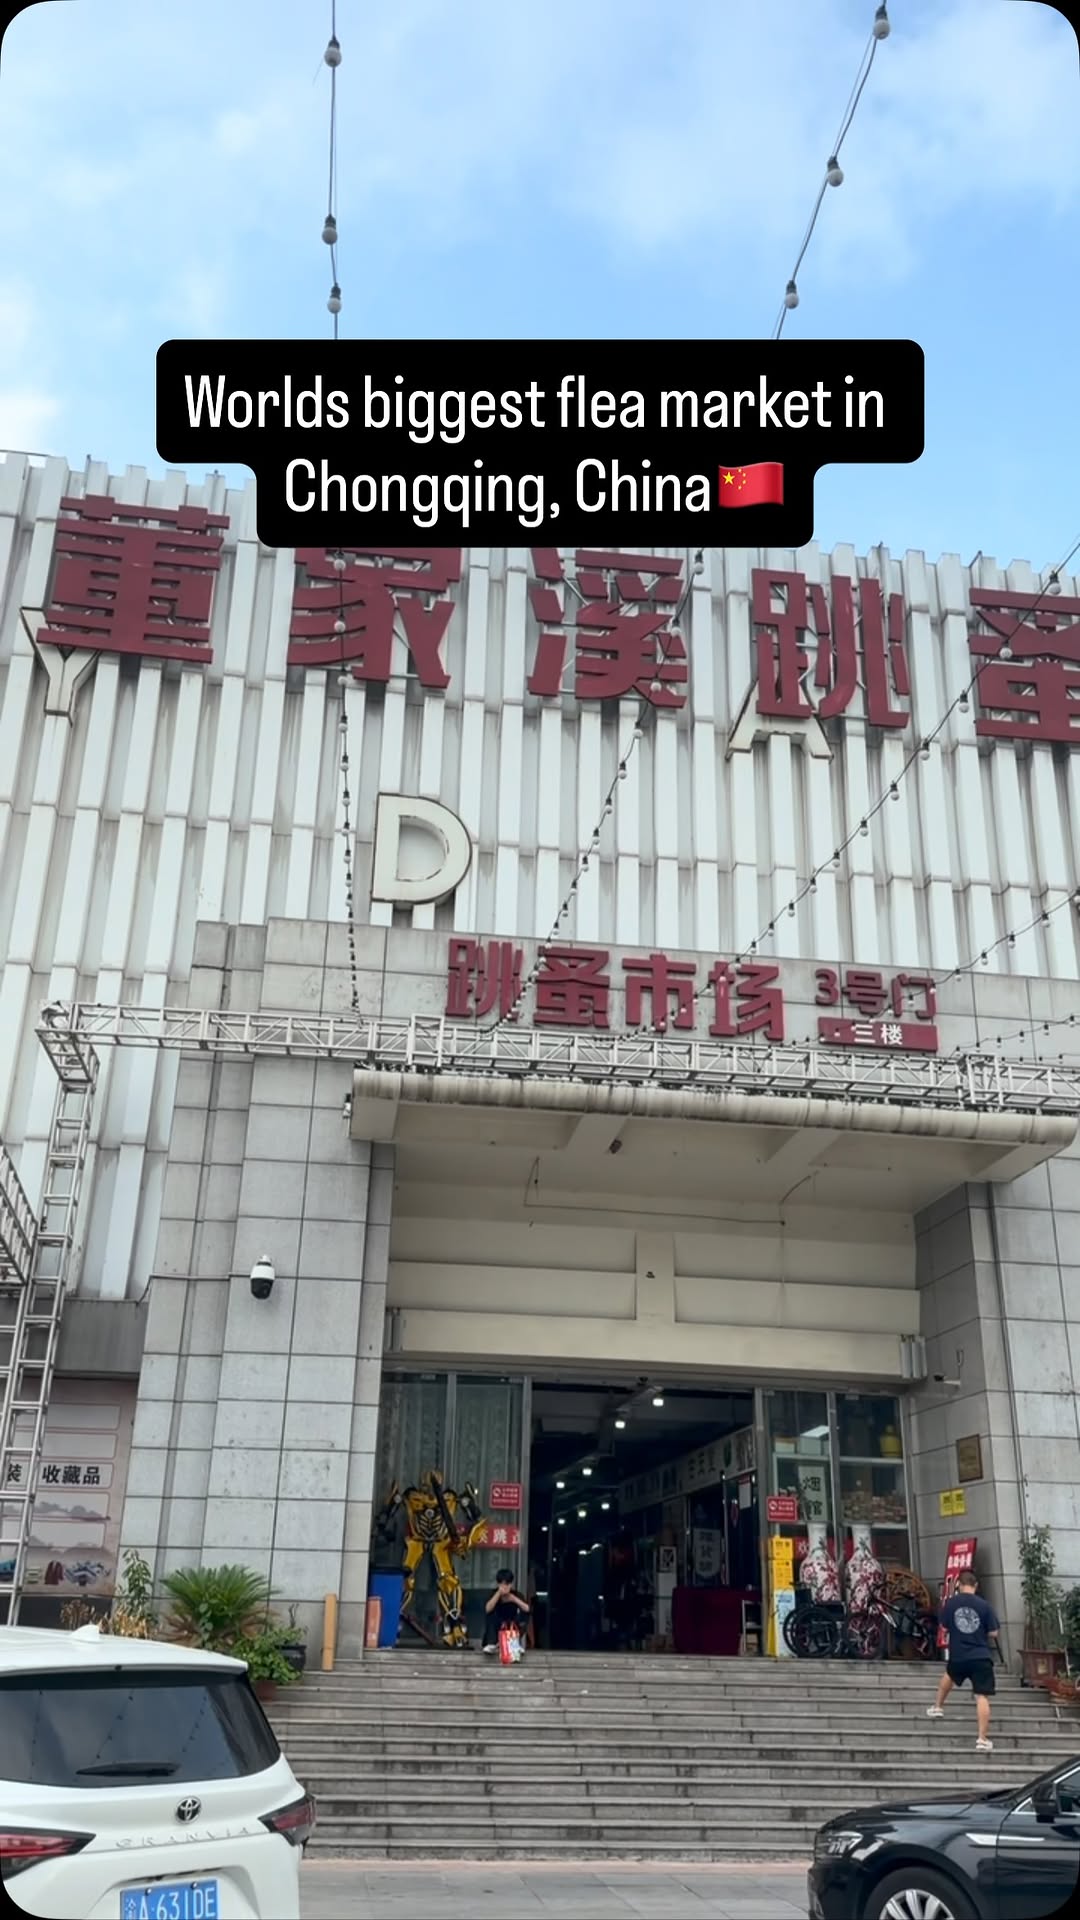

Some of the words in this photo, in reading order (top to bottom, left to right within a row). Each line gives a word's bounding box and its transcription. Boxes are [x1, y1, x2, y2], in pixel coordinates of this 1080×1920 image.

[370, 792, 473, 905] D
[445, 938, 785, 1042] 跳蚤市场
[814, 968, 937, 1019] 3号门
[853, 1023, 903, 1045] 三楼
[42, 1465, 100, 1484] 收藏品
